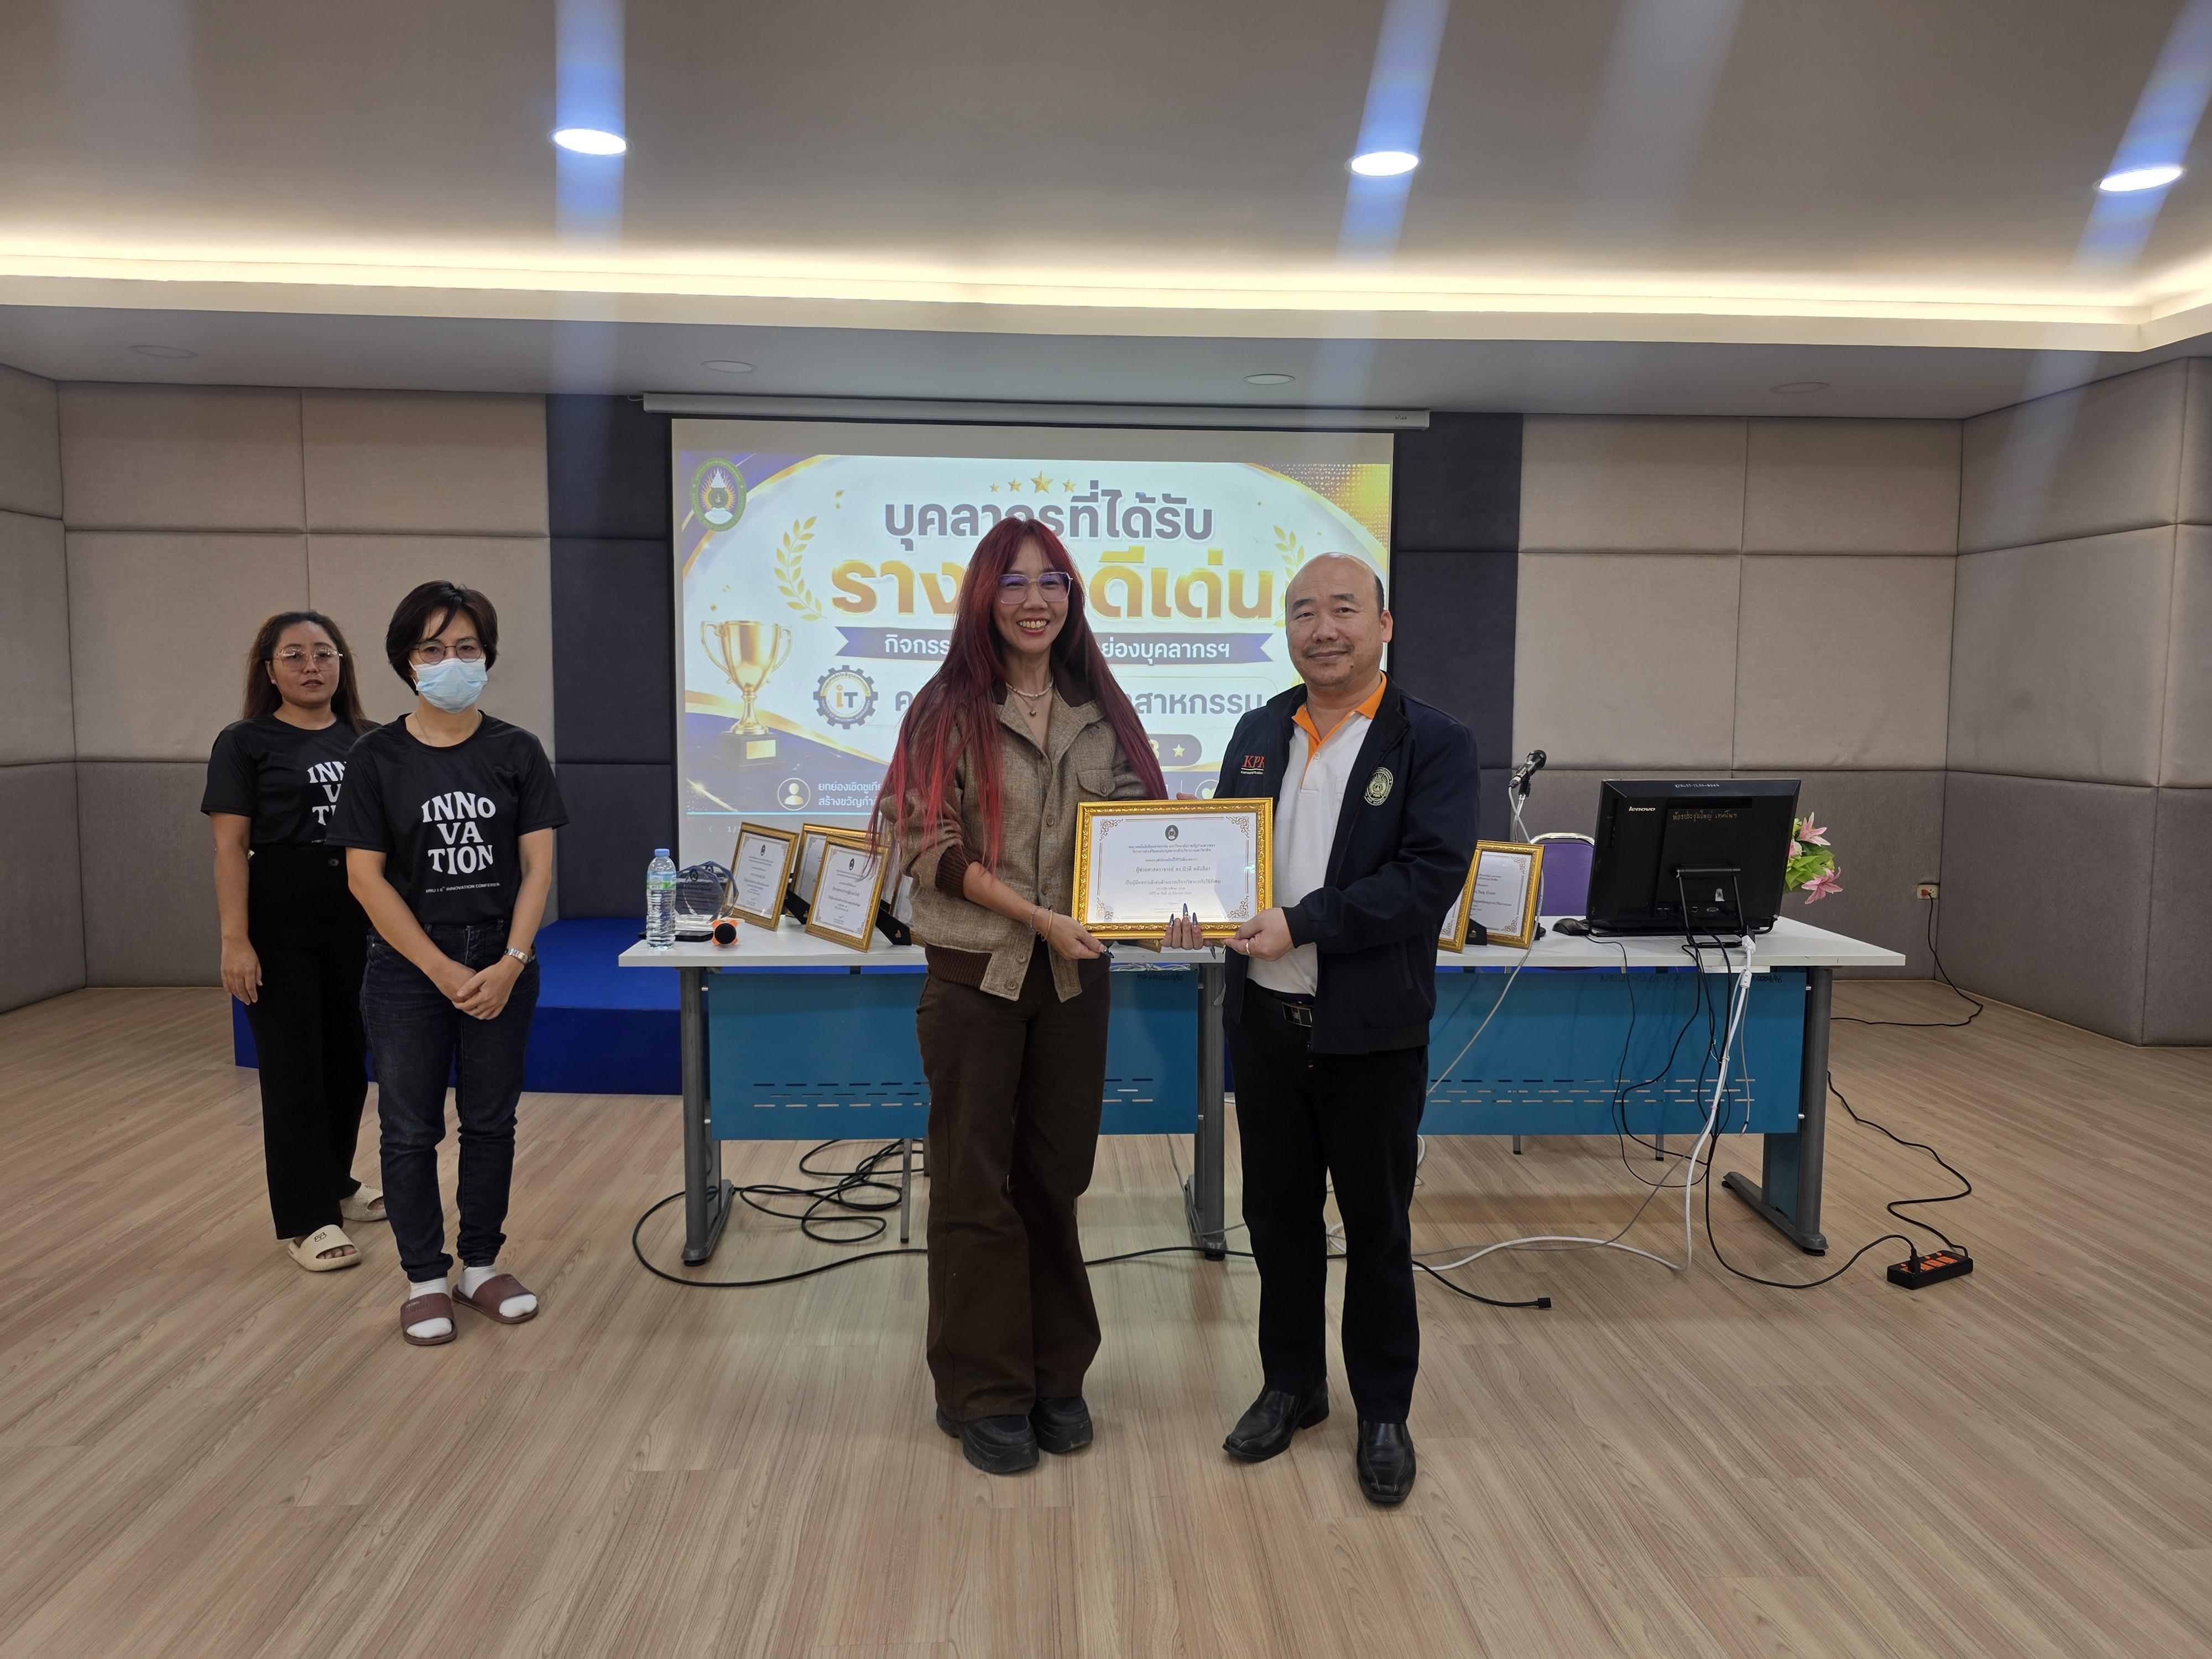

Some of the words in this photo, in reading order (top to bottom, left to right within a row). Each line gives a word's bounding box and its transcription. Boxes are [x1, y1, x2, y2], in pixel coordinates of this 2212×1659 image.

[885, 634, 950, 654] กิจกรร
[1101, 637, 1229, 665] ย่องบุคลากรฯ
[436, 821, 484, 844] VA
[428, 845, 493, 874] TION
